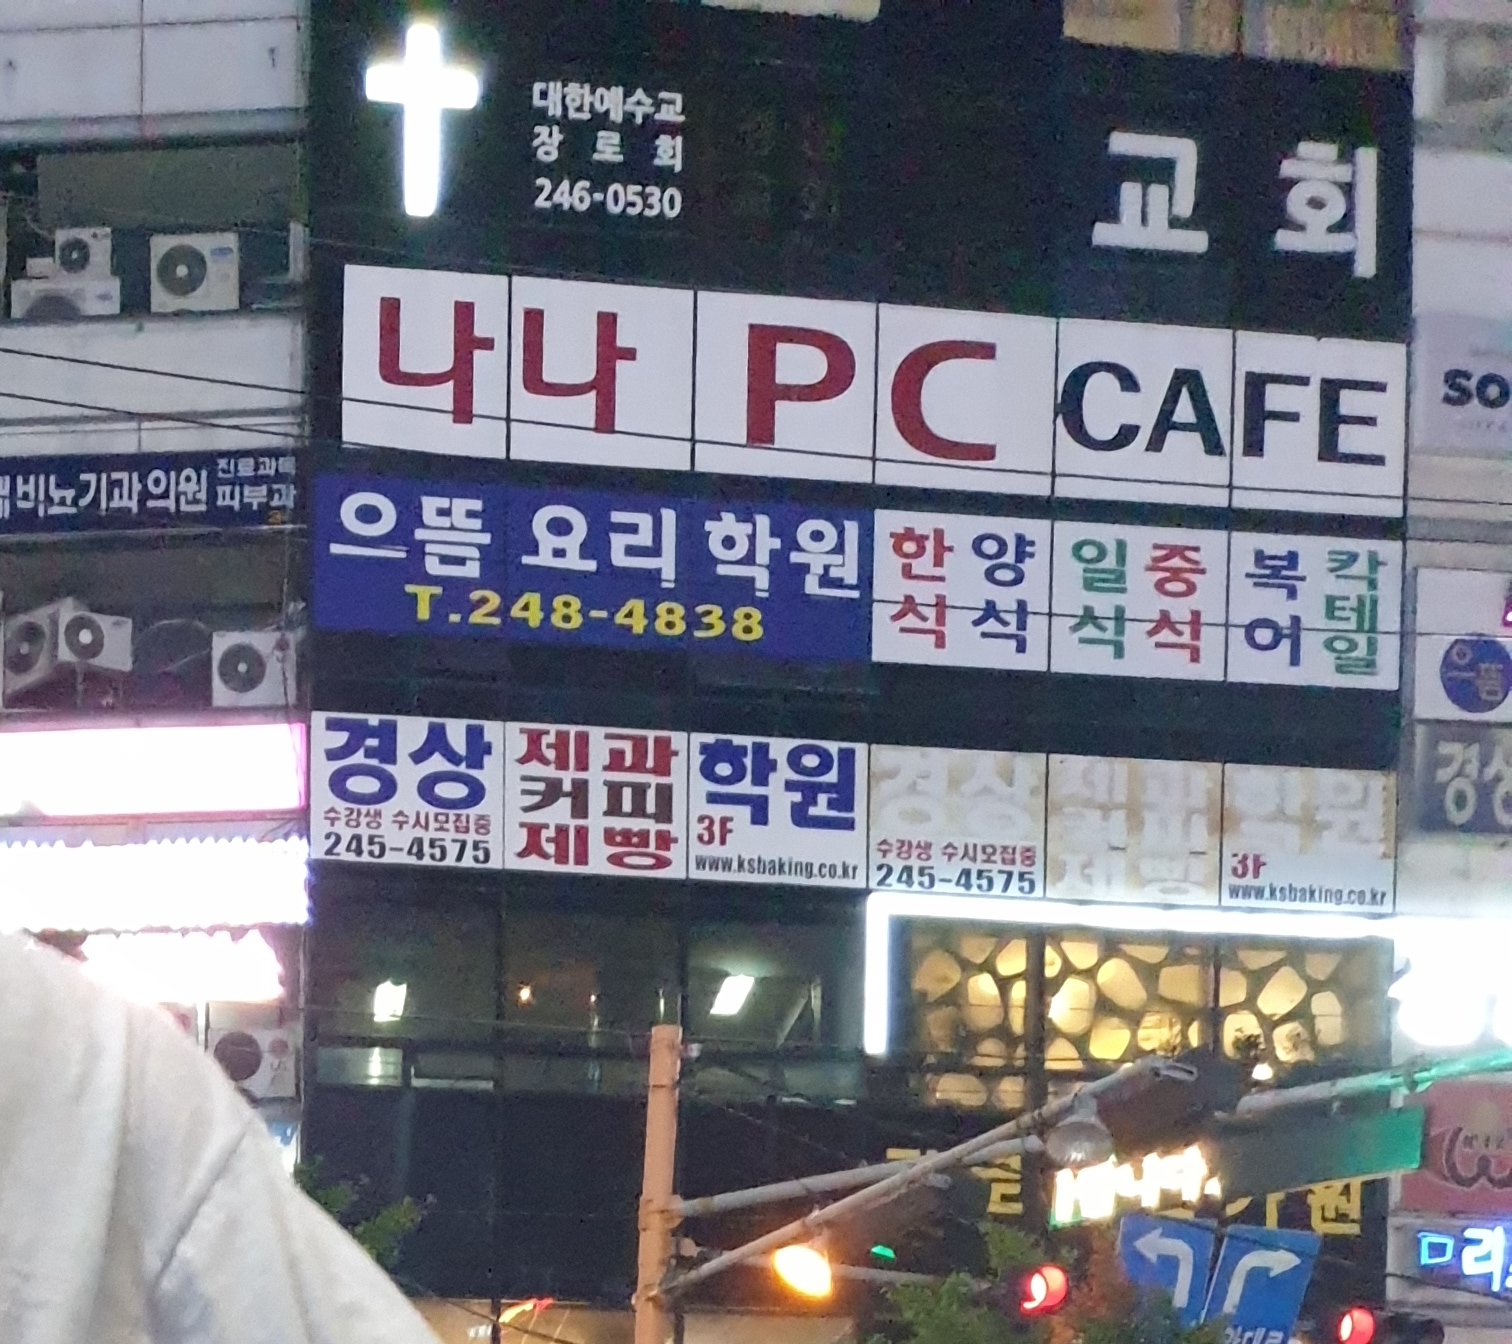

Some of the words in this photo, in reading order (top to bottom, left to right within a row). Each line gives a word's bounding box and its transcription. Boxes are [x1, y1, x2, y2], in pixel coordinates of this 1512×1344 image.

[531, 81, 685, 125] 대한예수교
[534, 177, 683, 219] 246-0530
[378, 296, 637, 434] 나나
[745, 323, 997, 463] PC
[1060, 361, 1388, 467] CAFE
[215, 483, 296, 511] 피부과
[329, 491, 491, 580] 으뜸
[521, 504, 678, 589] 요리
[704, 510, 861, 600] 학원
[404, 582, 765, 643] T.248-4838
[888, 525, 955, 651] 한식
[970, 532, 1037, 655] 양식
[1068, 537, 1128, 661] 일식
[1144, 542, 1207, 665] 중식
[1243, 547, 1307, 669] 복어
[1321, 549, 1388, 677] 칵테일
[324, 717, 492, 811] 경상
[516, 727, 679, 778] 제과
[520, 775, 675, 826] 커피
[697, 738, 856, 832] 학원
[323, 806, 383, 831] 수강생
[391, 810, 492, 837] 수시모집중
[515, 821, 679, 872] 제빵
[696, 815, 734, 848] 3F
[324, 832, 491, 866] 245-4575
[694, 852, 859, 882] www.ksbaking.co.kr
[875, 838, 934, 860] 수강생
[941, 843, 1037, 867] 수시모집중
[875, 863, 1037, 896] 245-4575
[1228, 882, 1388, 908] www.ksbaking.co.kr
